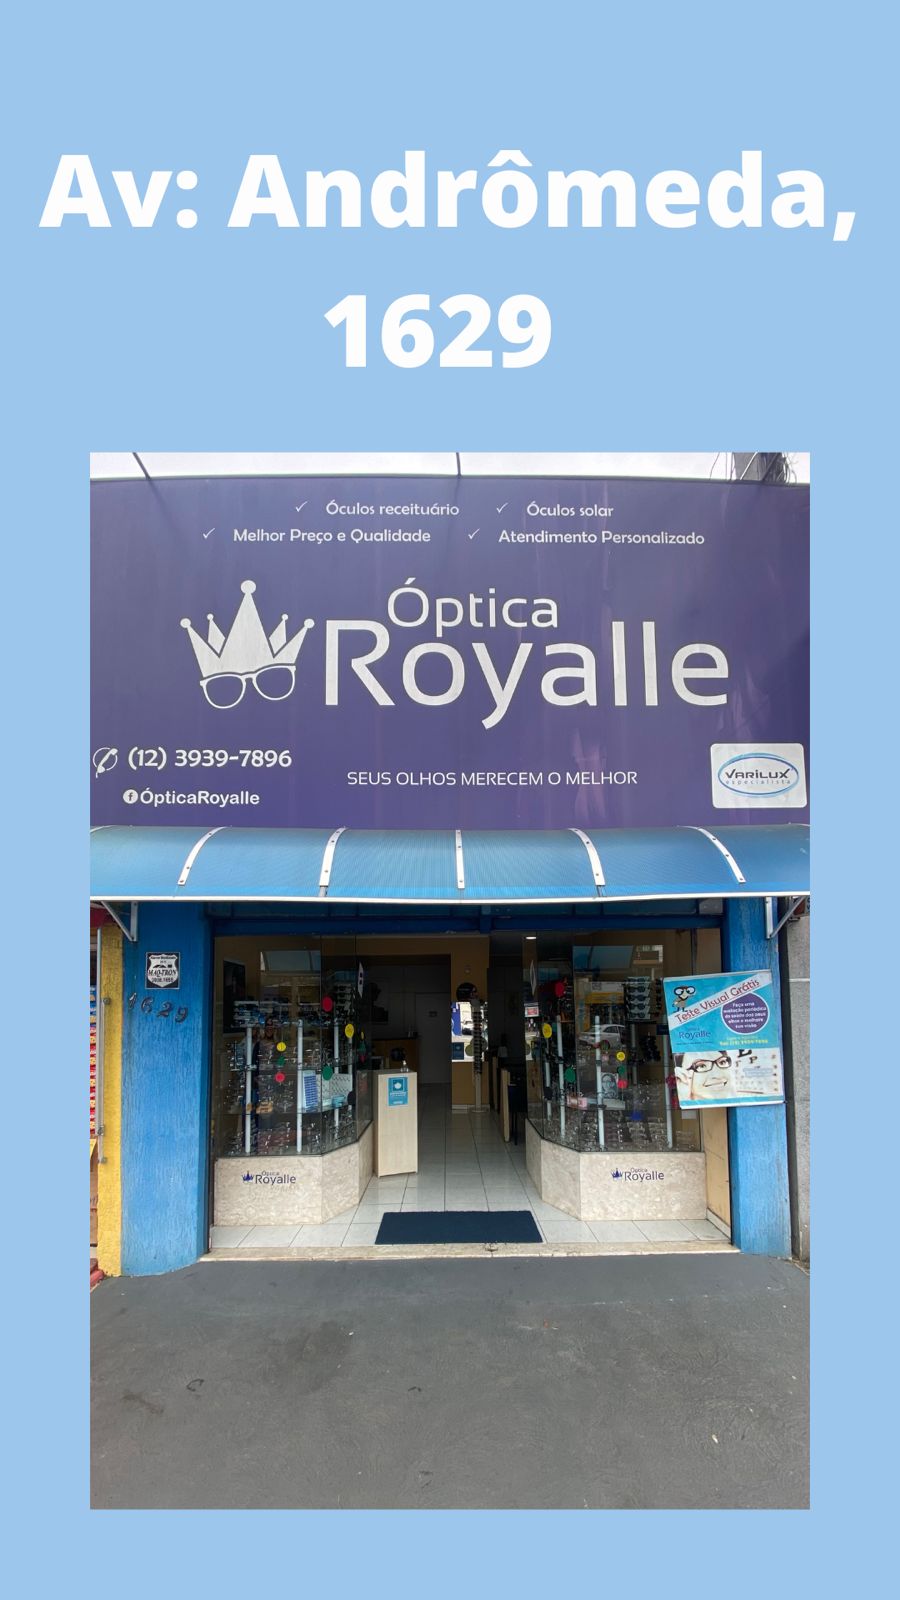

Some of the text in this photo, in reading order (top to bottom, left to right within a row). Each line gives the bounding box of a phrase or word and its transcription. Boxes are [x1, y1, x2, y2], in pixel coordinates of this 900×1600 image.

[325, 499, 460, 515] Óculos receituário
[526, 500, 614, 517] Óculos solar
[233, 528, 431, 545] Melhor Preço e Qualidade
[498, 529, 705, 545] Atendimento Personalizado
[387, 577, 558, 637] Óptica
[325, 619, 729, 729] Royalle
[128, 746, 292, 771] (12) 3939-7896
[347, 771, 638, 786] SEUS OLHOS MERECEM O MELHOR
[140, 787, 260, 807] ÓpticaRoyalle
[129, 992, 188, 1023] 1629
[675, 978, 760, 1023] Teste Visual Grátis
[679, 1030, 712, 1040] Royalle
[255, 1174, 296, 1186] Royalle
[624, 1170, 665, 1182] Royalle
